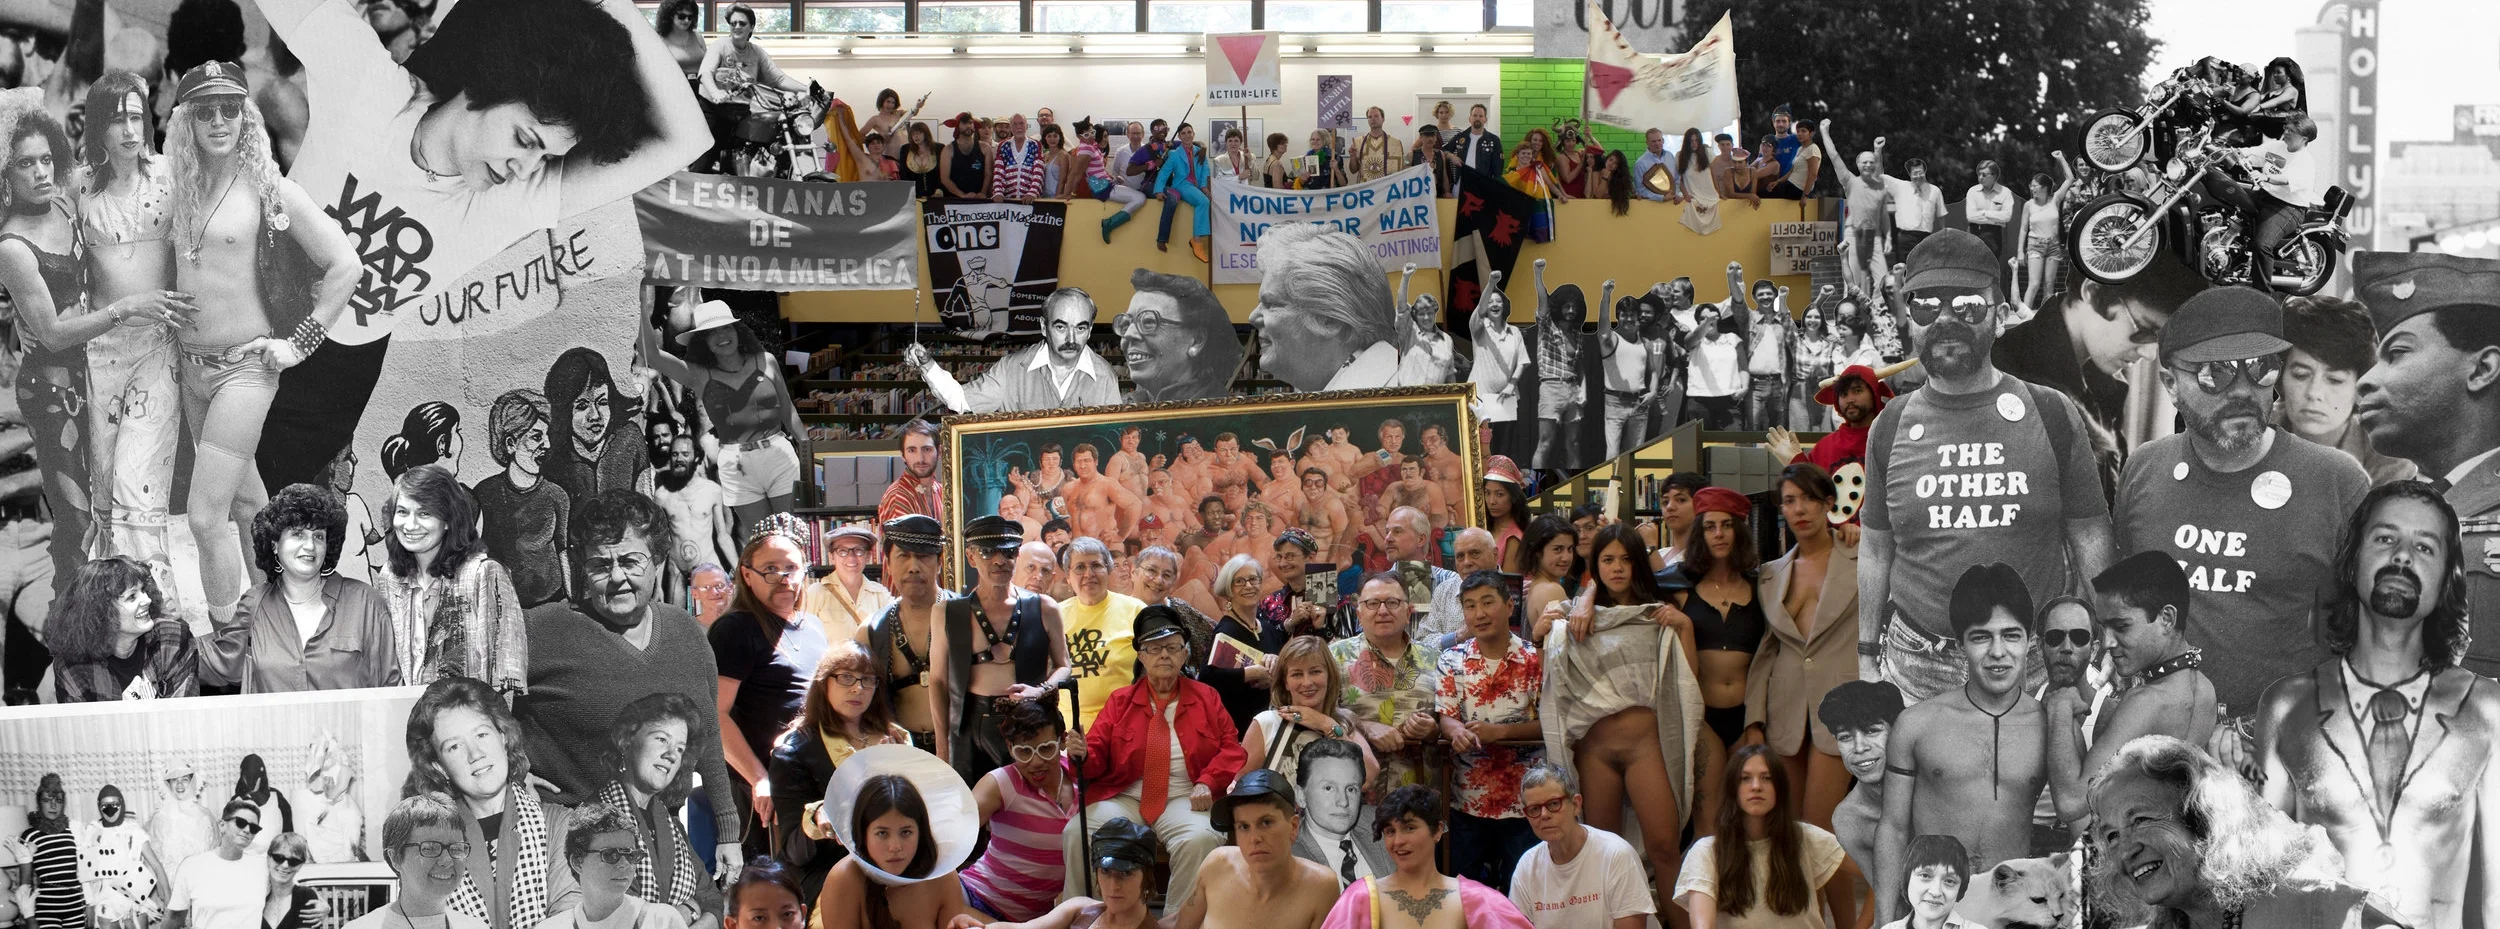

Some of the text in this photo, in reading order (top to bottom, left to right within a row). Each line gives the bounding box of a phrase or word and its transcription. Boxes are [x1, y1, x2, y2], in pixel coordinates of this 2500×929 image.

[1320, 78, 1352, 108] LESBIAN
[1321, 95, 1351, 123] MILITIA
[667, 179, 868, 216] LESBIANAS
[1229, 175, 1431, 215] MONEY FOR AIDS
[925, 209, 1064, 228] The Homosexual Magazine
[1380, 205, 1429, 231] WAR
[1773, 223, 1813, 235] PROFIT
[750, 219, 793, 248] DE
[1811, 230, 1835, 242] NOT
[1786, 245, 1833, 257] PEOPLE
[495, 228, 595, 311] FUTURE
[652, 252, 912, 285] ATINOAMERICA
[1937, 442, 2005, 467] THE
[1916, 471, 2029, 498] OTHER
[1928, 503, 2020, 529] HALF
[2174, 524, 2247, 557] ONE
[2177, 560, 2256, 593] ALF
